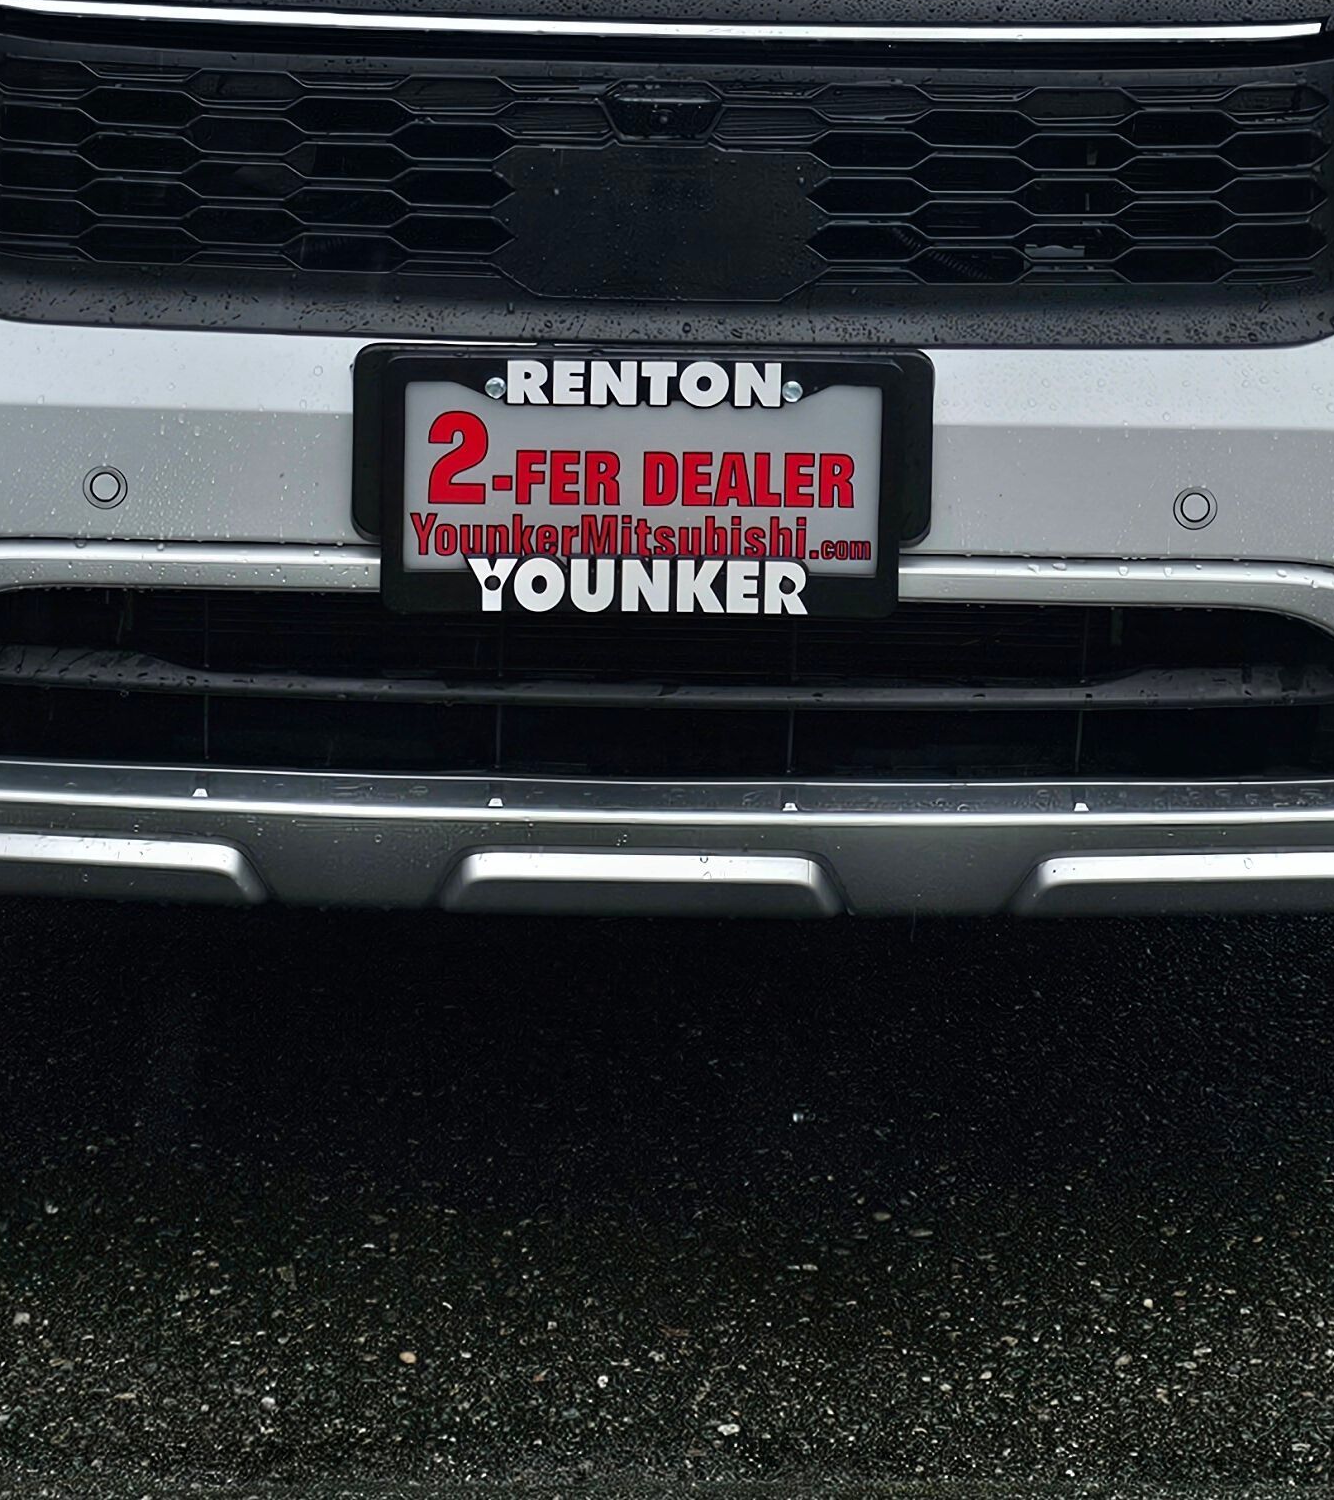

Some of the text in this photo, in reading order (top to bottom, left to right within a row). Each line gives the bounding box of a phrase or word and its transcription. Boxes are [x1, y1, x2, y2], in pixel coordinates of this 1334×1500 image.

[507, 360, 782, 408] RENTON
[427, 410, 855, 509] 2-FER DEALER
[410, 512, 872, 561] YounkerMitsubishi.com
[467, 557, 809, 616] YOUNKER
